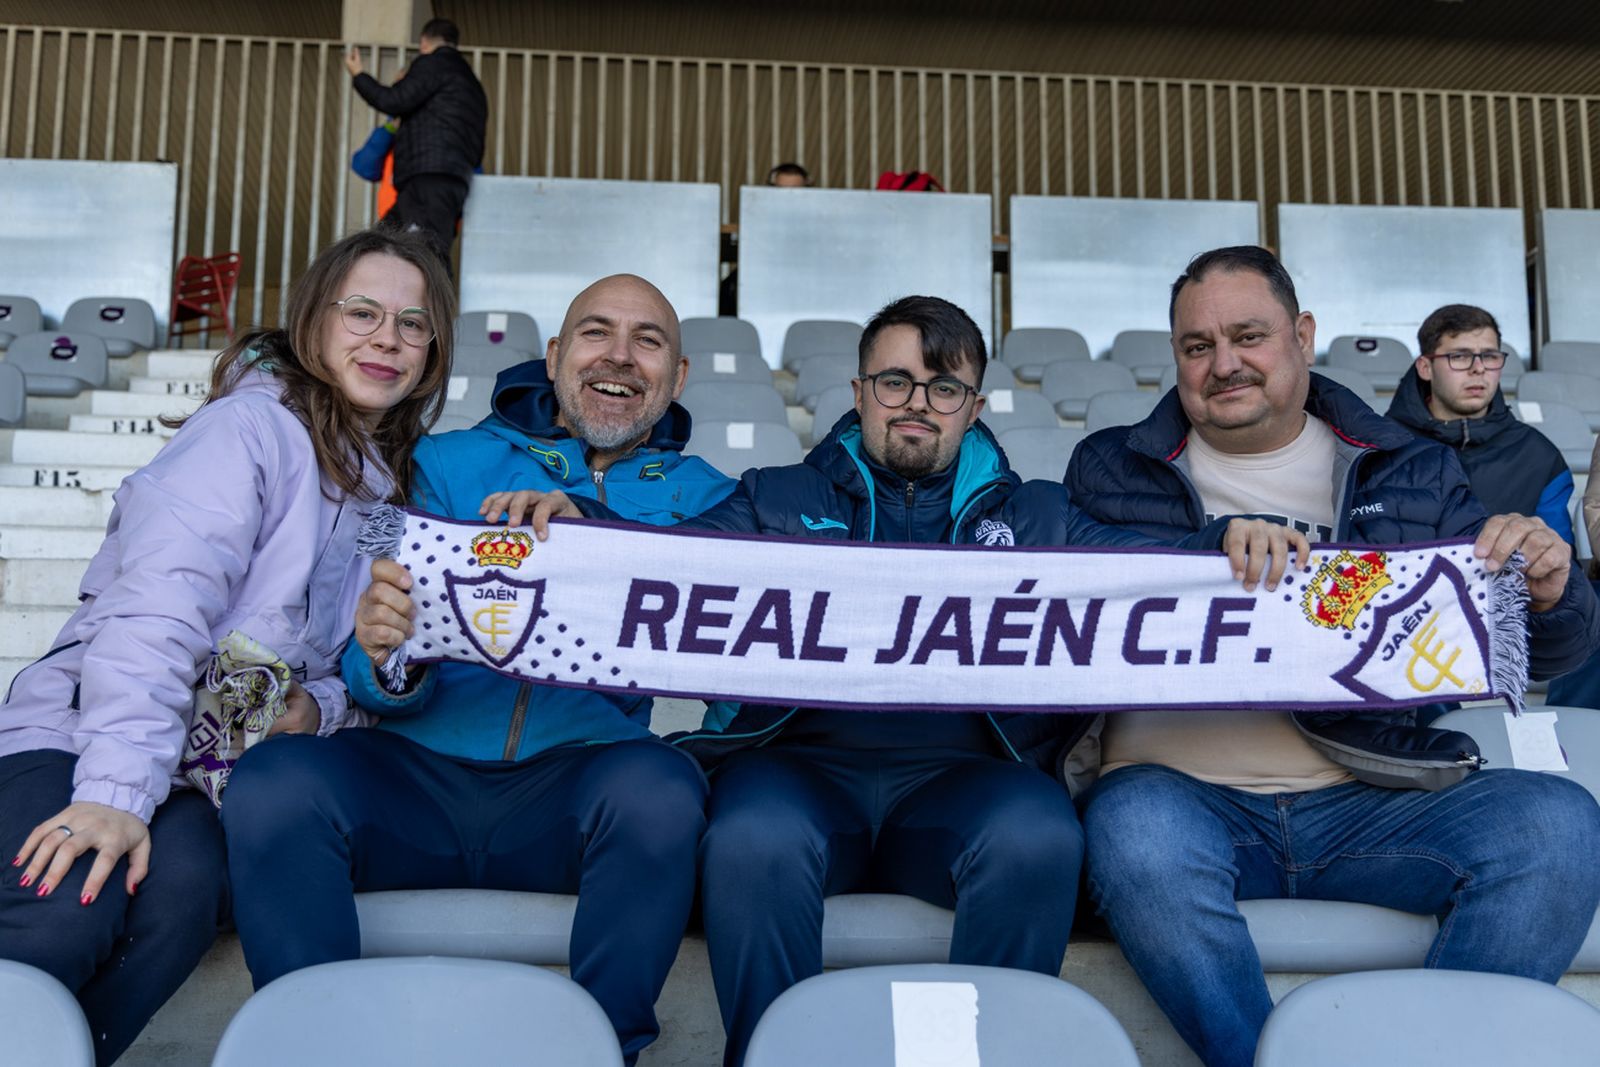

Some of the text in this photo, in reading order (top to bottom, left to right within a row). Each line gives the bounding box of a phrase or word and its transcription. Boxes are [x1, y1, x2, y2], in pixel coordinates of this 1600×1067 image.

[112, 419, 155, 434] F14
[472, 585, 518, 601] JAÉN
[616, 577, 1272, 667] REAL JAÉN C.F.
[1381, 600, 1432, 662] JAÉN
